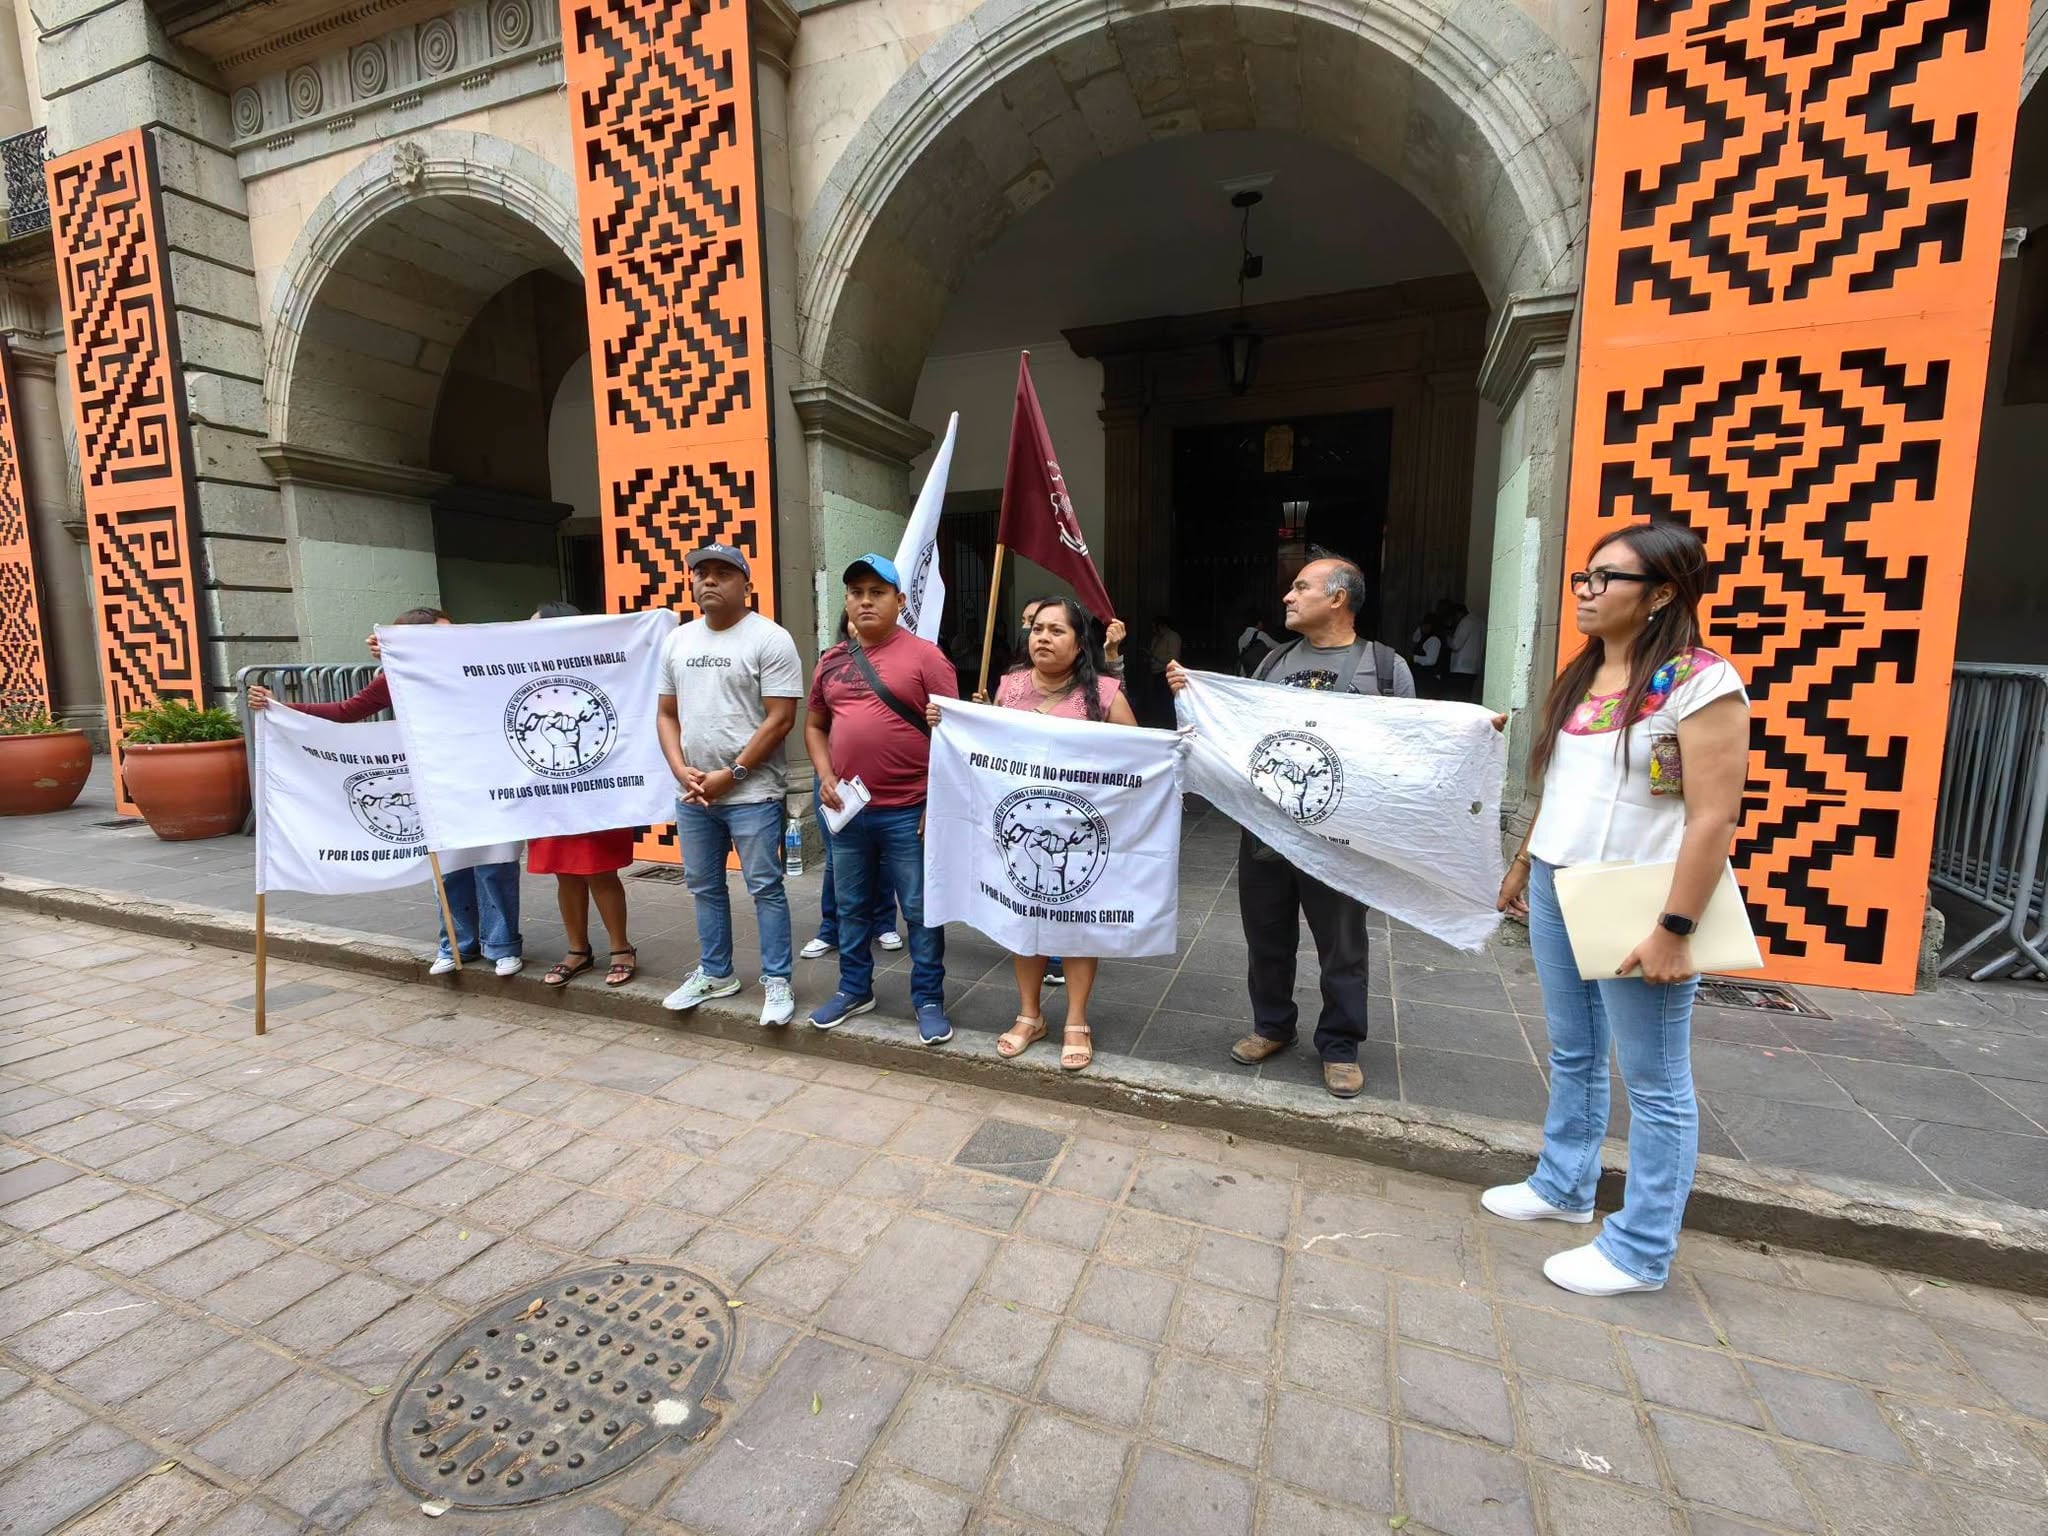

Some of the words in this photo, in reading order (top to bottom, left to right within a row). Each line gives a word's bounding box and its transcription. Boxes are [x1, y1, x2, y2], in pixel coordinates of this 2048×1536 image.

[463, 665, 486, 677] POR
[486, 664, 506, 676] LOS
[507, 662, 527, 676] QUE
[528, 661, 541, 672] YA
[541, 659, 555, 672] NO
[557, 655, 593, 670] PUEDEN
[593, 651, 627, 665] HABLAR
[509, 702, 517, 711] DE
[588, 685, 597, 693] DE
[600, 695, 615, 721] MASACRE
[320, 750, 338, 763] LOS
[339, 753, 360, 765] QUE
[359, 754, 373, 765] YA
[374, 754, 390, 765] NO
[527, 759, 535, 768] DE
[535, 766, 549, 776] SAN
[577, 763, 591, 774] DEL
[591, 751, 606, 766] MAR
[969, 752, 989, 769] POR
[989, 756, 1008, 773] LOS
[1009, 760, 1029, 777] QUE
[1029, 763, 1041, 779] YA
[1042, 766, 1057, 781] NO
[1058, 768, 1100, 785] PUEDEN
[1101, 772, 1143, 789] HABLAR
[1331, 755, 1341, 784] MASACRE
[489, 789, 496, 801] Y
[497, 788, 515, 800] POR
[516, 786, 534, 799] LOS
[534, 784, 551, 798] QUE
[570, 777, 616, 794] PODEMOS
[616, 775, 645, 788] GRITAR
[1029, 788, 1065, 799] FAMILIARES
[1065, 793, 1087, 809] IKOOTS
[1084, 804, 1095, 815] DE
[368, 824, 379, 833] DE
[378, 831, 395, 841] SAN
[318, 849, 326, 861] Y
[327, 849, 348, 861] POR
[350, 849, 369, 862] LOS
[371, 849, 391, 862] QUE
[1007, 870, 1016, 882] DE
[1016, 880, 1030, 896] SAN
[1031, 890, 1058, 903] MATEO
[1060, 892, 1076, 902] DEL
[1075, 878, 1092, 895] MAR
[980, 881, 986, 893] Y
[985, 884, 999, 901] POR
[999, 891, 1012, 909] LOS
[1012, 901, 1028, 917] QUE
[1050, 909, 1097, 924] PODEMOS
[1098, 909, 1135, 924] GRITAR
